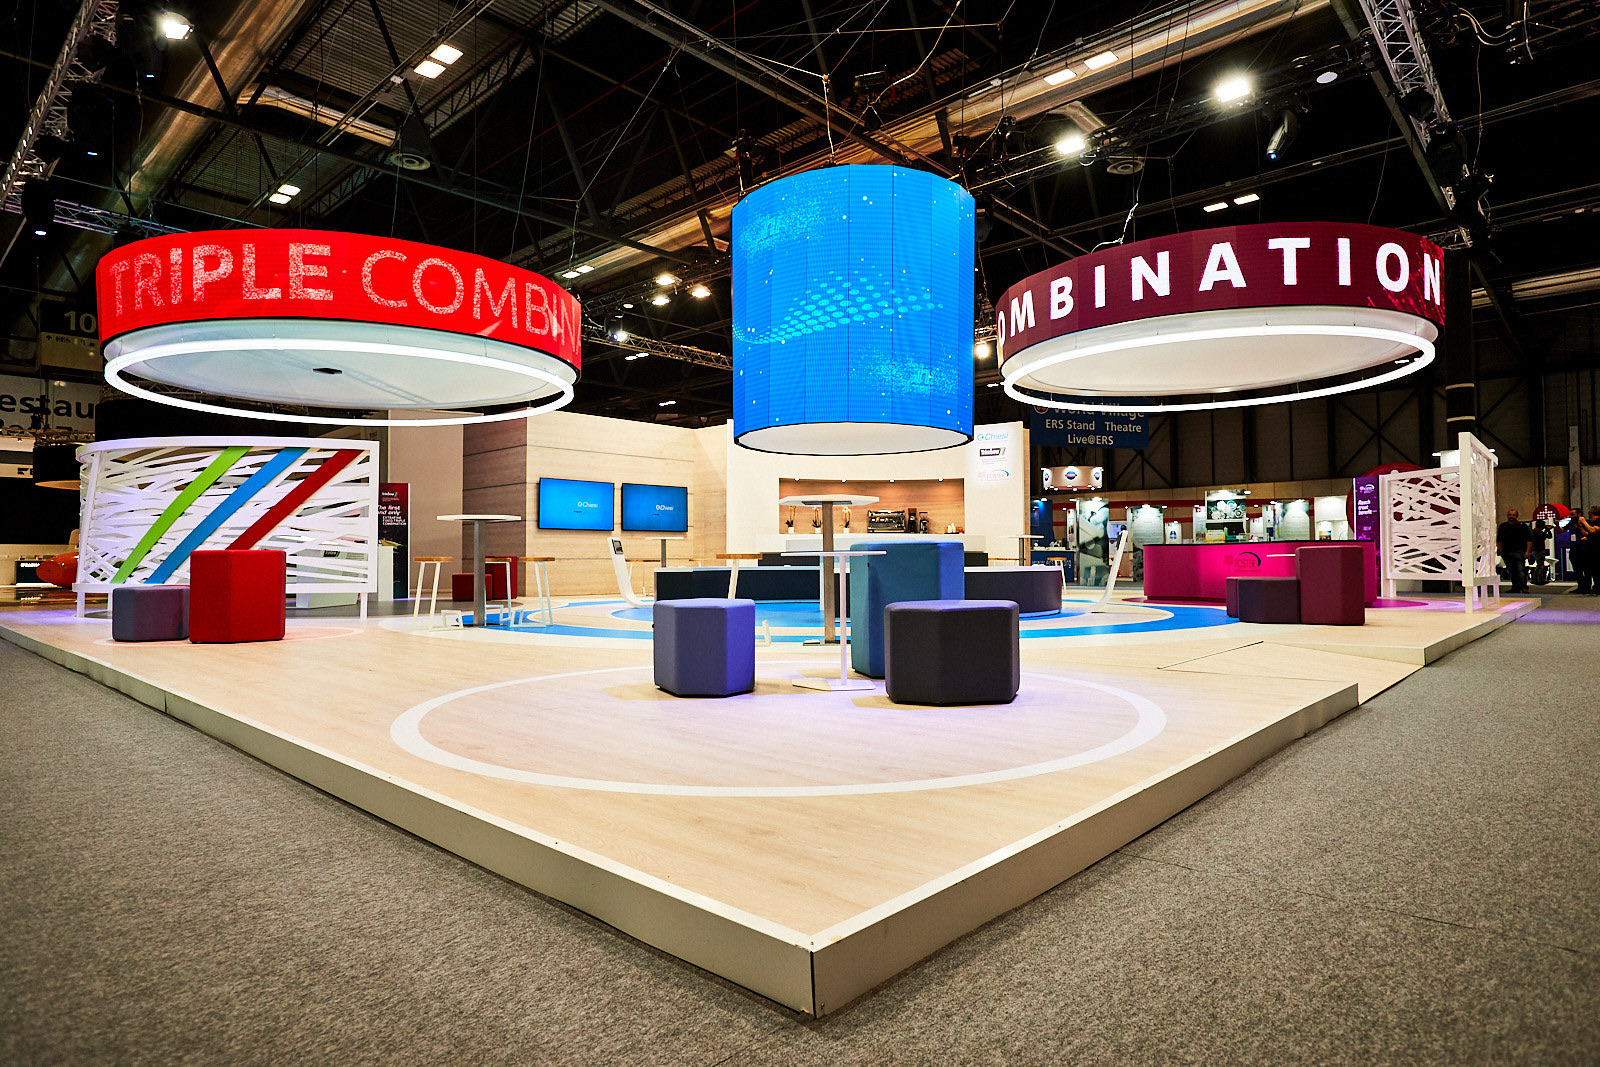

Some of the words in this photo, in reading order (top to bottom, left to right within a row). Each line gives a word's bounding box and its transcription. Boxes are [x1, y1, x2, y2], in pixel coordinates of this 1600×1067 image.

[108, 242, 334, 317] TRIPLE
[997, 237, 1443, 347] OMBINATION
[64, 310, 97, 333] 10
[1045, 419, 1064, 429] ERS
[1066, 420, 1095, 430] Stand
[1104, 421, 1142, 432] Theatre
[1067, 433, 1114, 445] Live@ERS
[1234, 558, 1256, 568] FOSTER
